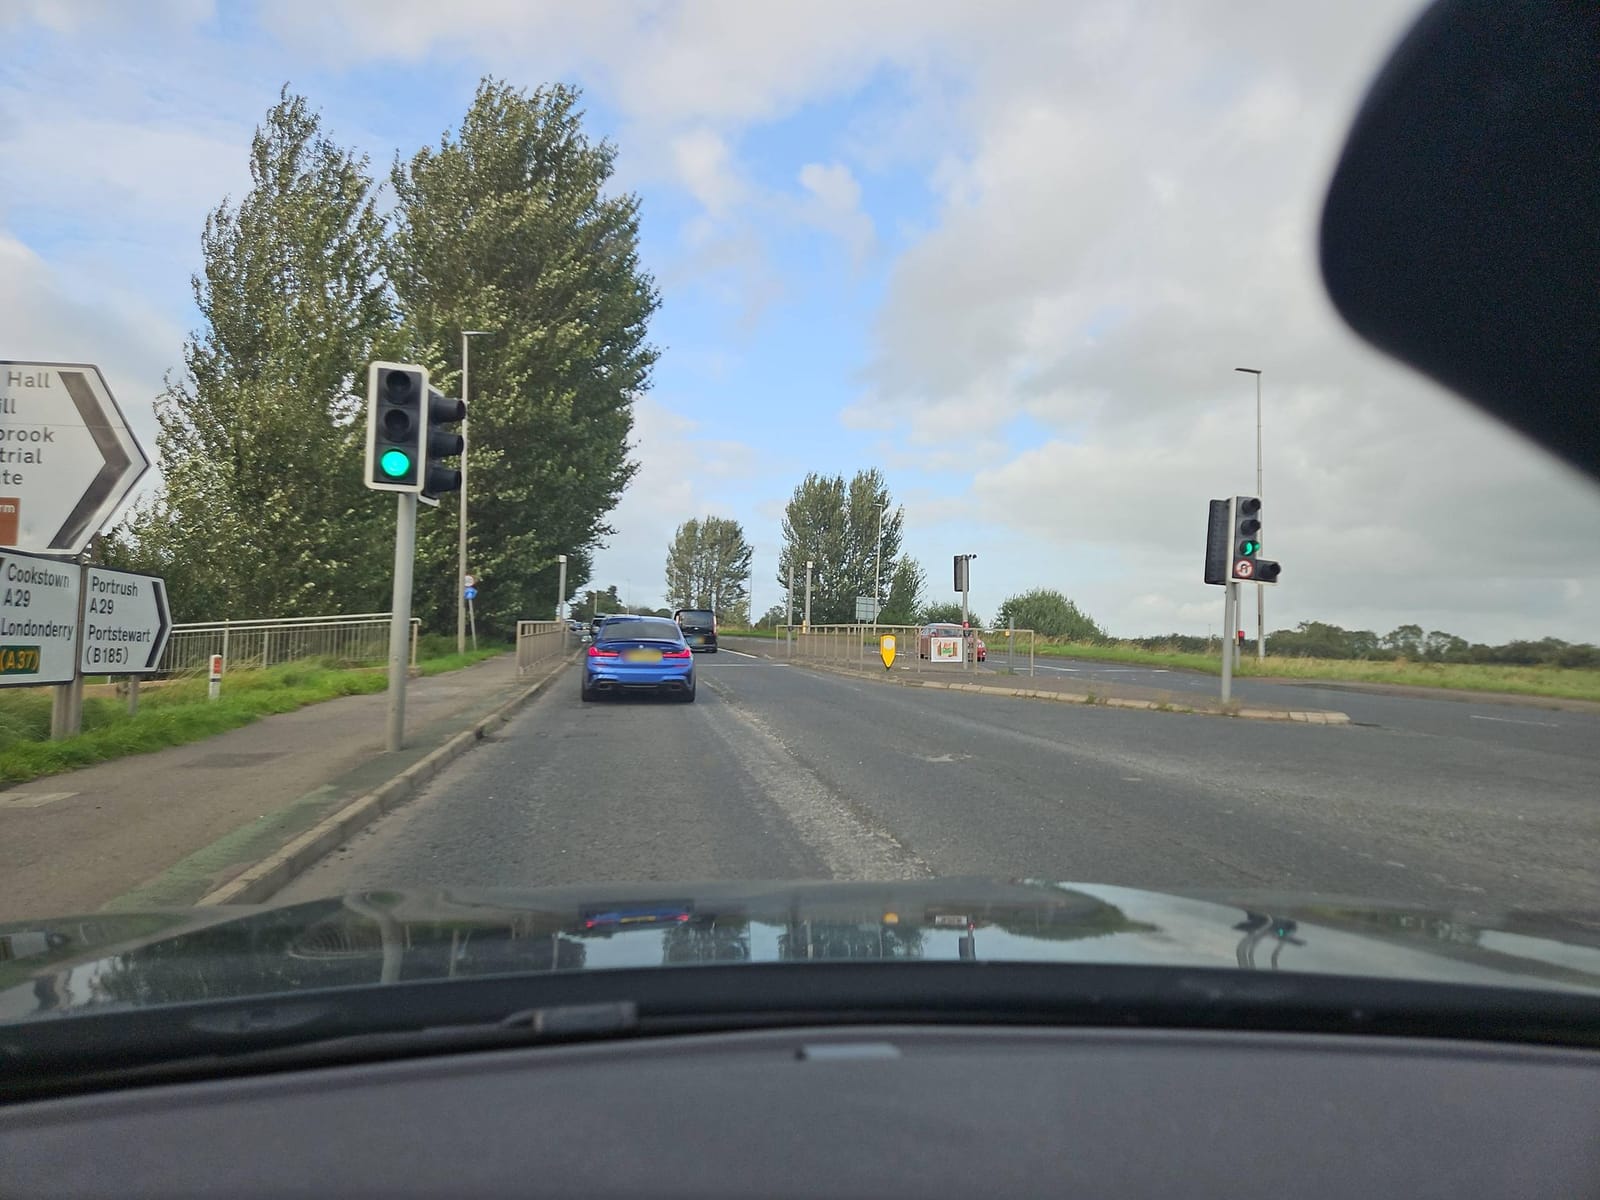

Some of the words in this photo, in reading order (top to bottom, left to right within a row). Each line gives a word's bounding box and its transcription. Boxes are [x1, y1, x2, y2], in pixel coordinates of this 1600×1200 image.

[7, 371, 50, 388] Hall
[7, 563, 69, 588] Cookstown
[92, 576, 138, 597] Portrush
[3, 588, 31, 608] A29
[89, 598, 114, 615] A29
[1, 618, 74, 641] Londonderry
[88, 624, 151, 643] Portstewart
[0, 650, 39, 672] (A37)
[86, 646, 129, 665] (B185)
